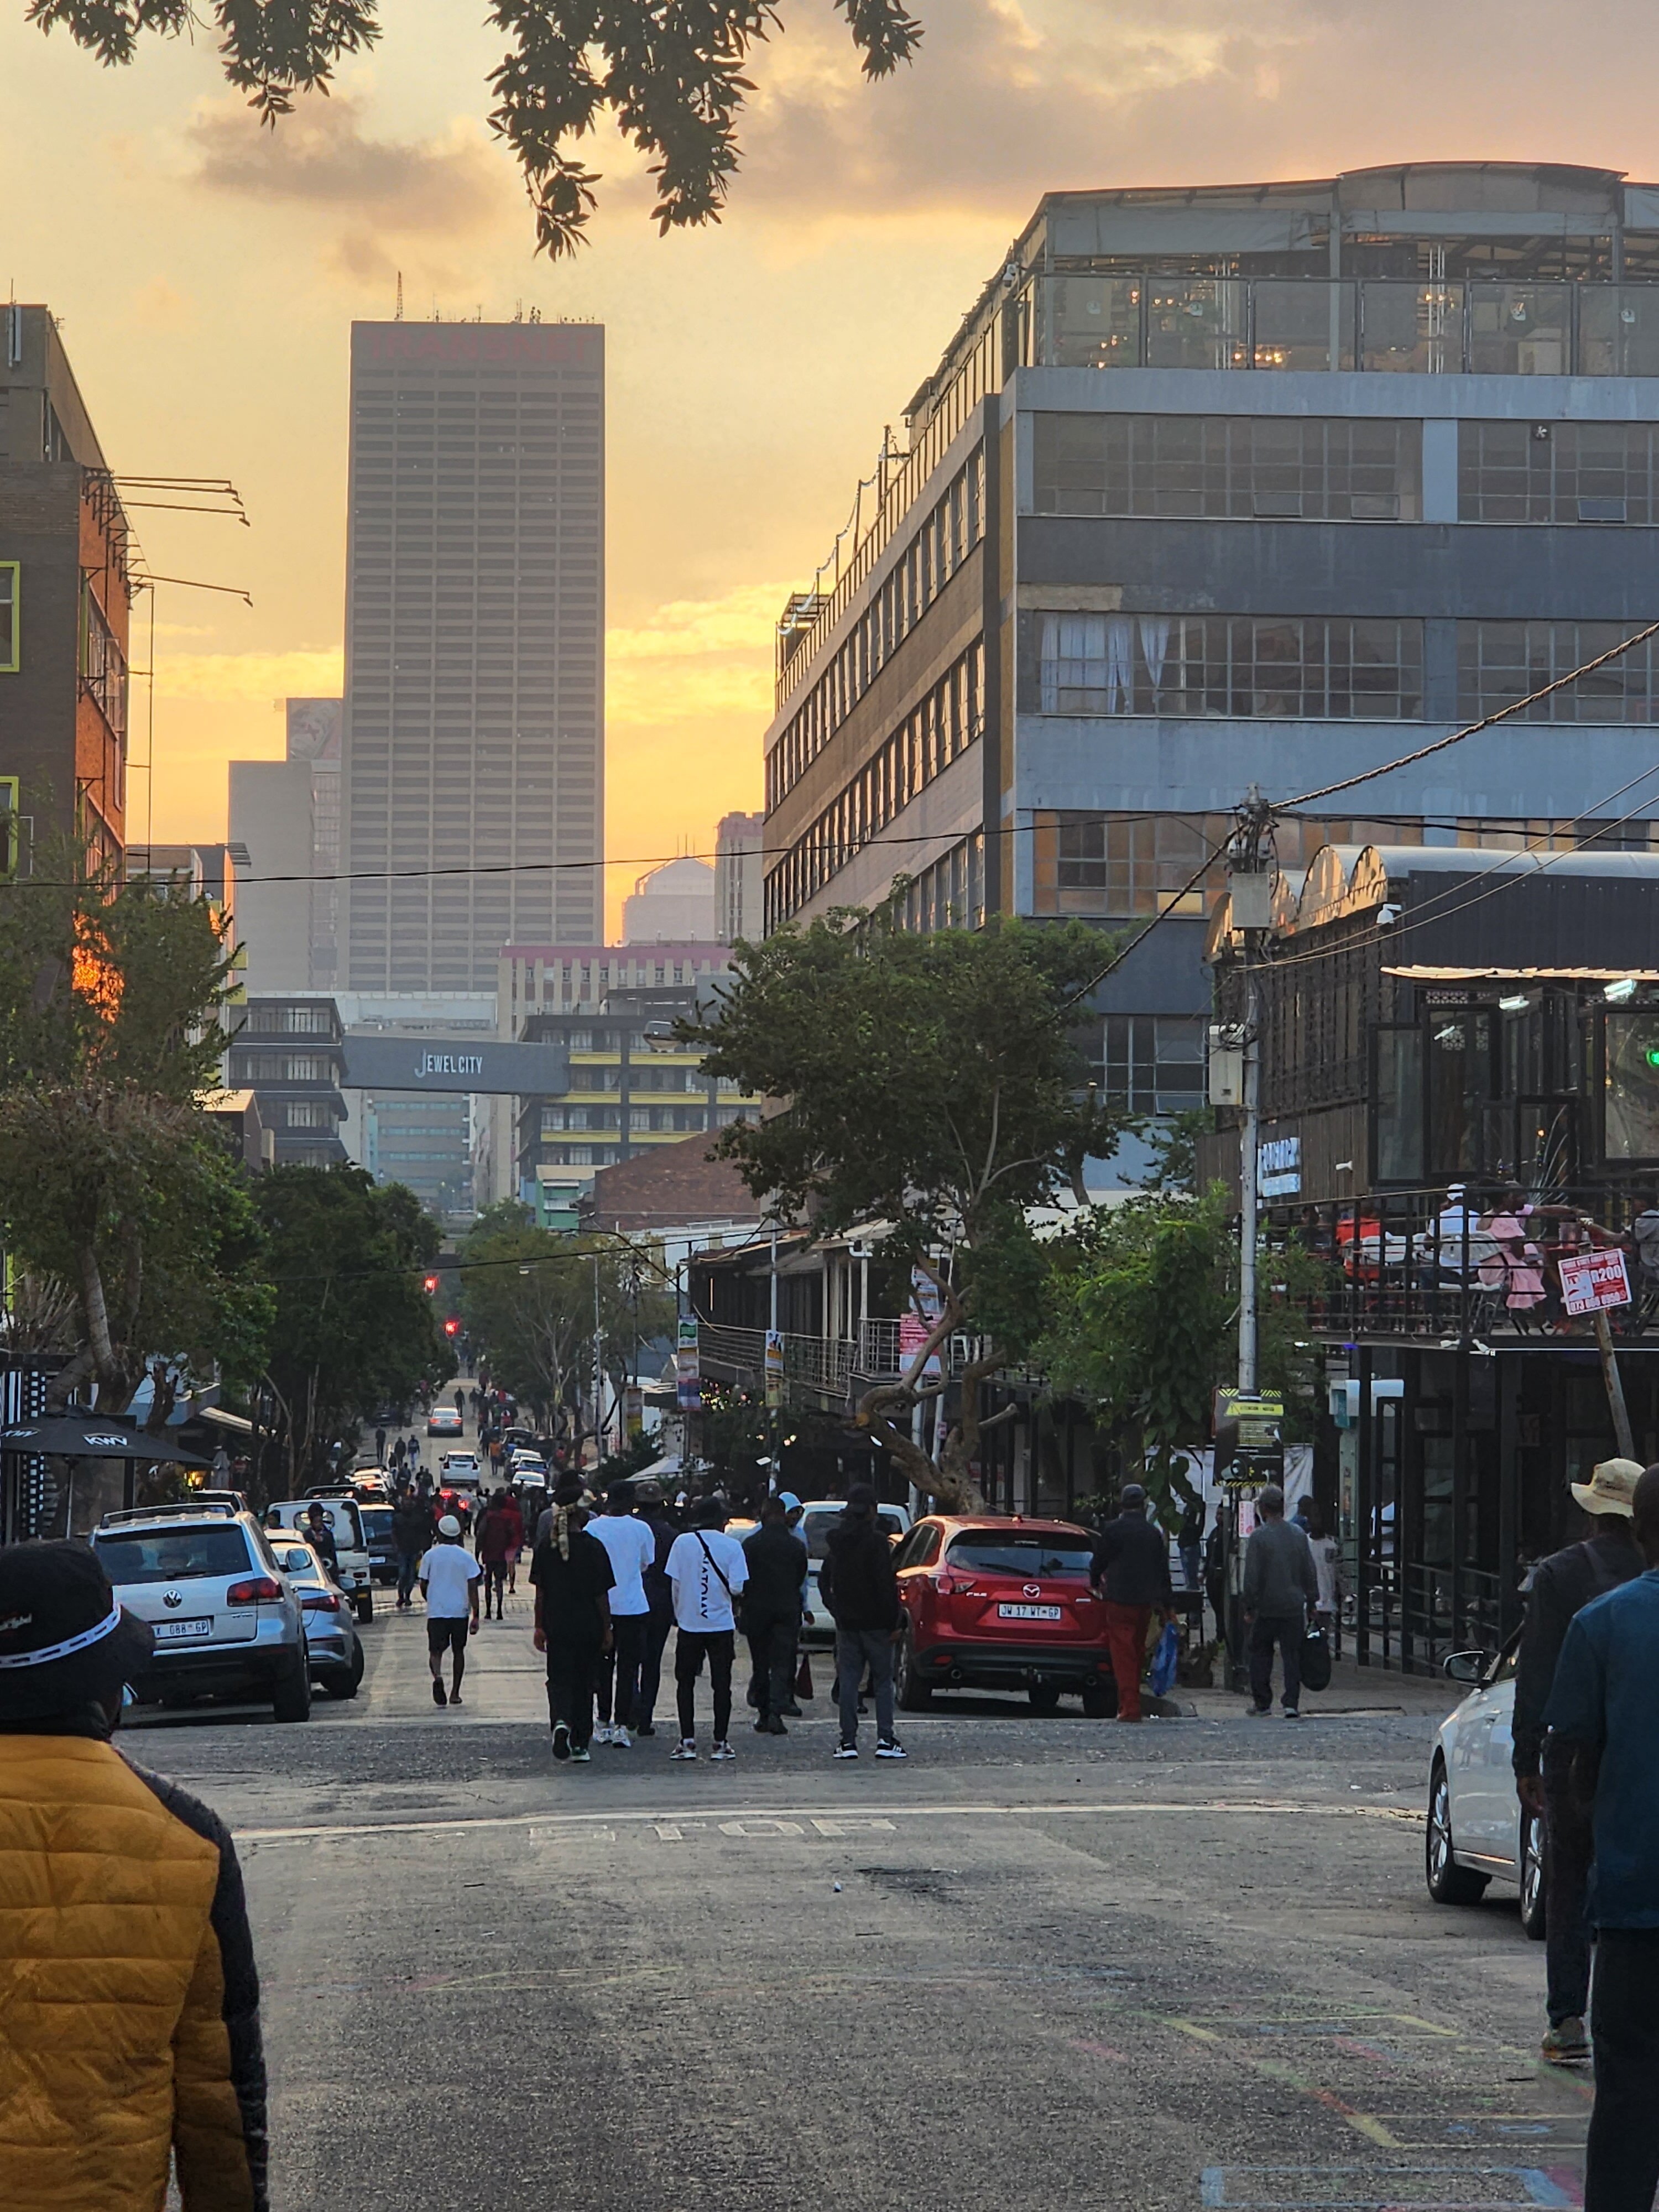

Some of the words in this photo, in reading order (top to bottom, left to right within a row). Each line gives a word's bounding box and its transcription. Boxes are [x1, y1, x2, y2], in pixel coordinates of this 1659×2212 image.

[362, 332, 596, 360] TRANSNET
[414, 1048, 457, 1078] JEWEL
[458, 1055, 482, 1074] CITY
[84, 1436, 127, 1446] KWV
[1001, 1605, 1012, 1615] JW
[1016, 1606, 1027, 1616] 17
[1030, 1606, 1041, 1616] WT
[1048, 1608, 1058, 1618] GP
[169, 1624, 186, 1635] 088
[195, 1621, 206, 1632] GP
